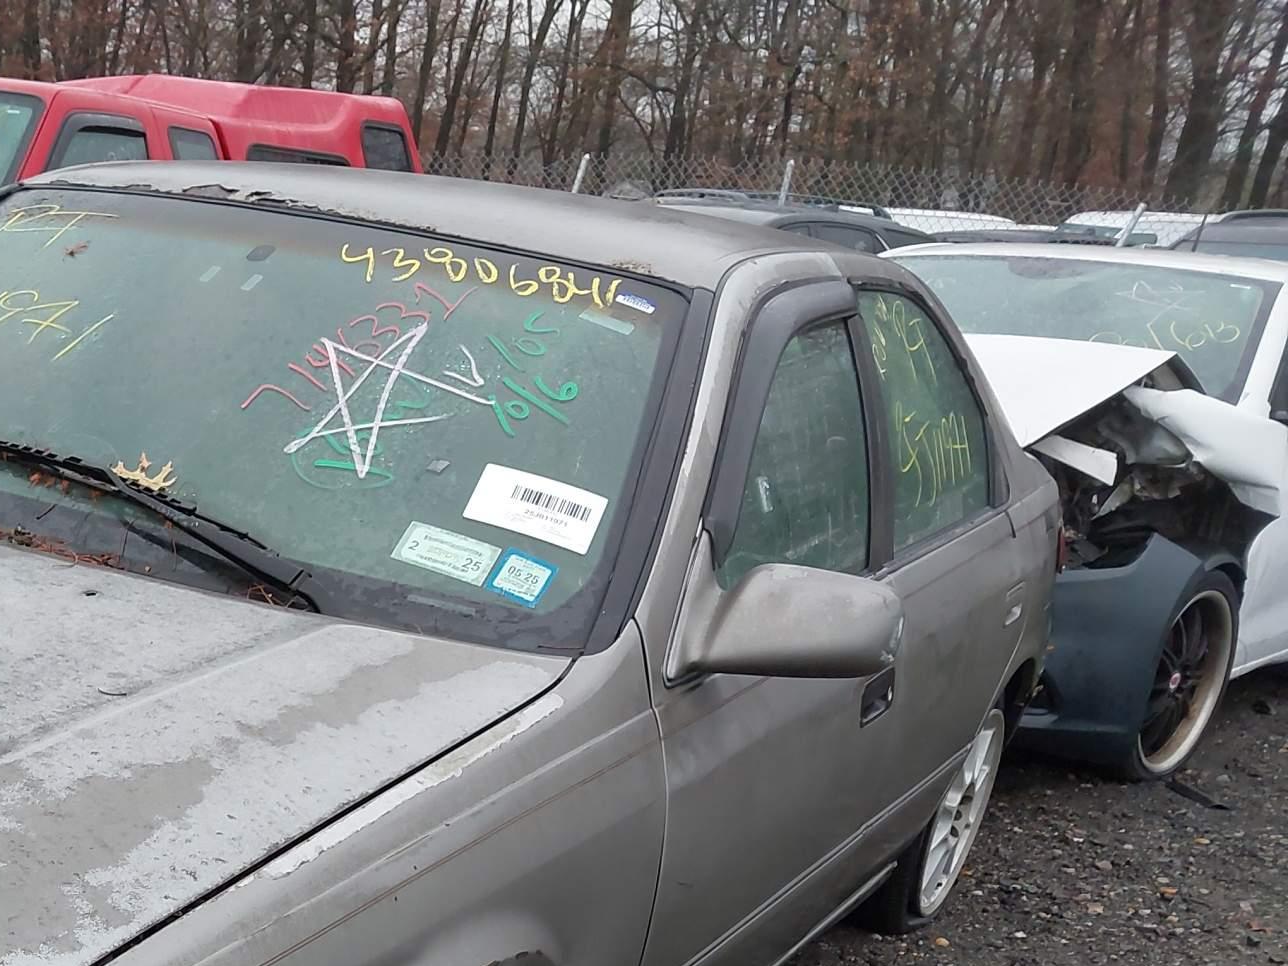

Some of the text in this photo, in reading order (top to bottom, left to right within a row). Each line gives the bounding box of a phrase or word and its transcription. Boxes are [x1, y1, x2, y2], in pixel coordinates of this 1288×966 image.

[341, 243, 622, 308] 43806841
[408, 540, 420, 551] 2
[462, 557, 484, 573] 25
[523, 572, 540, 586] 25
